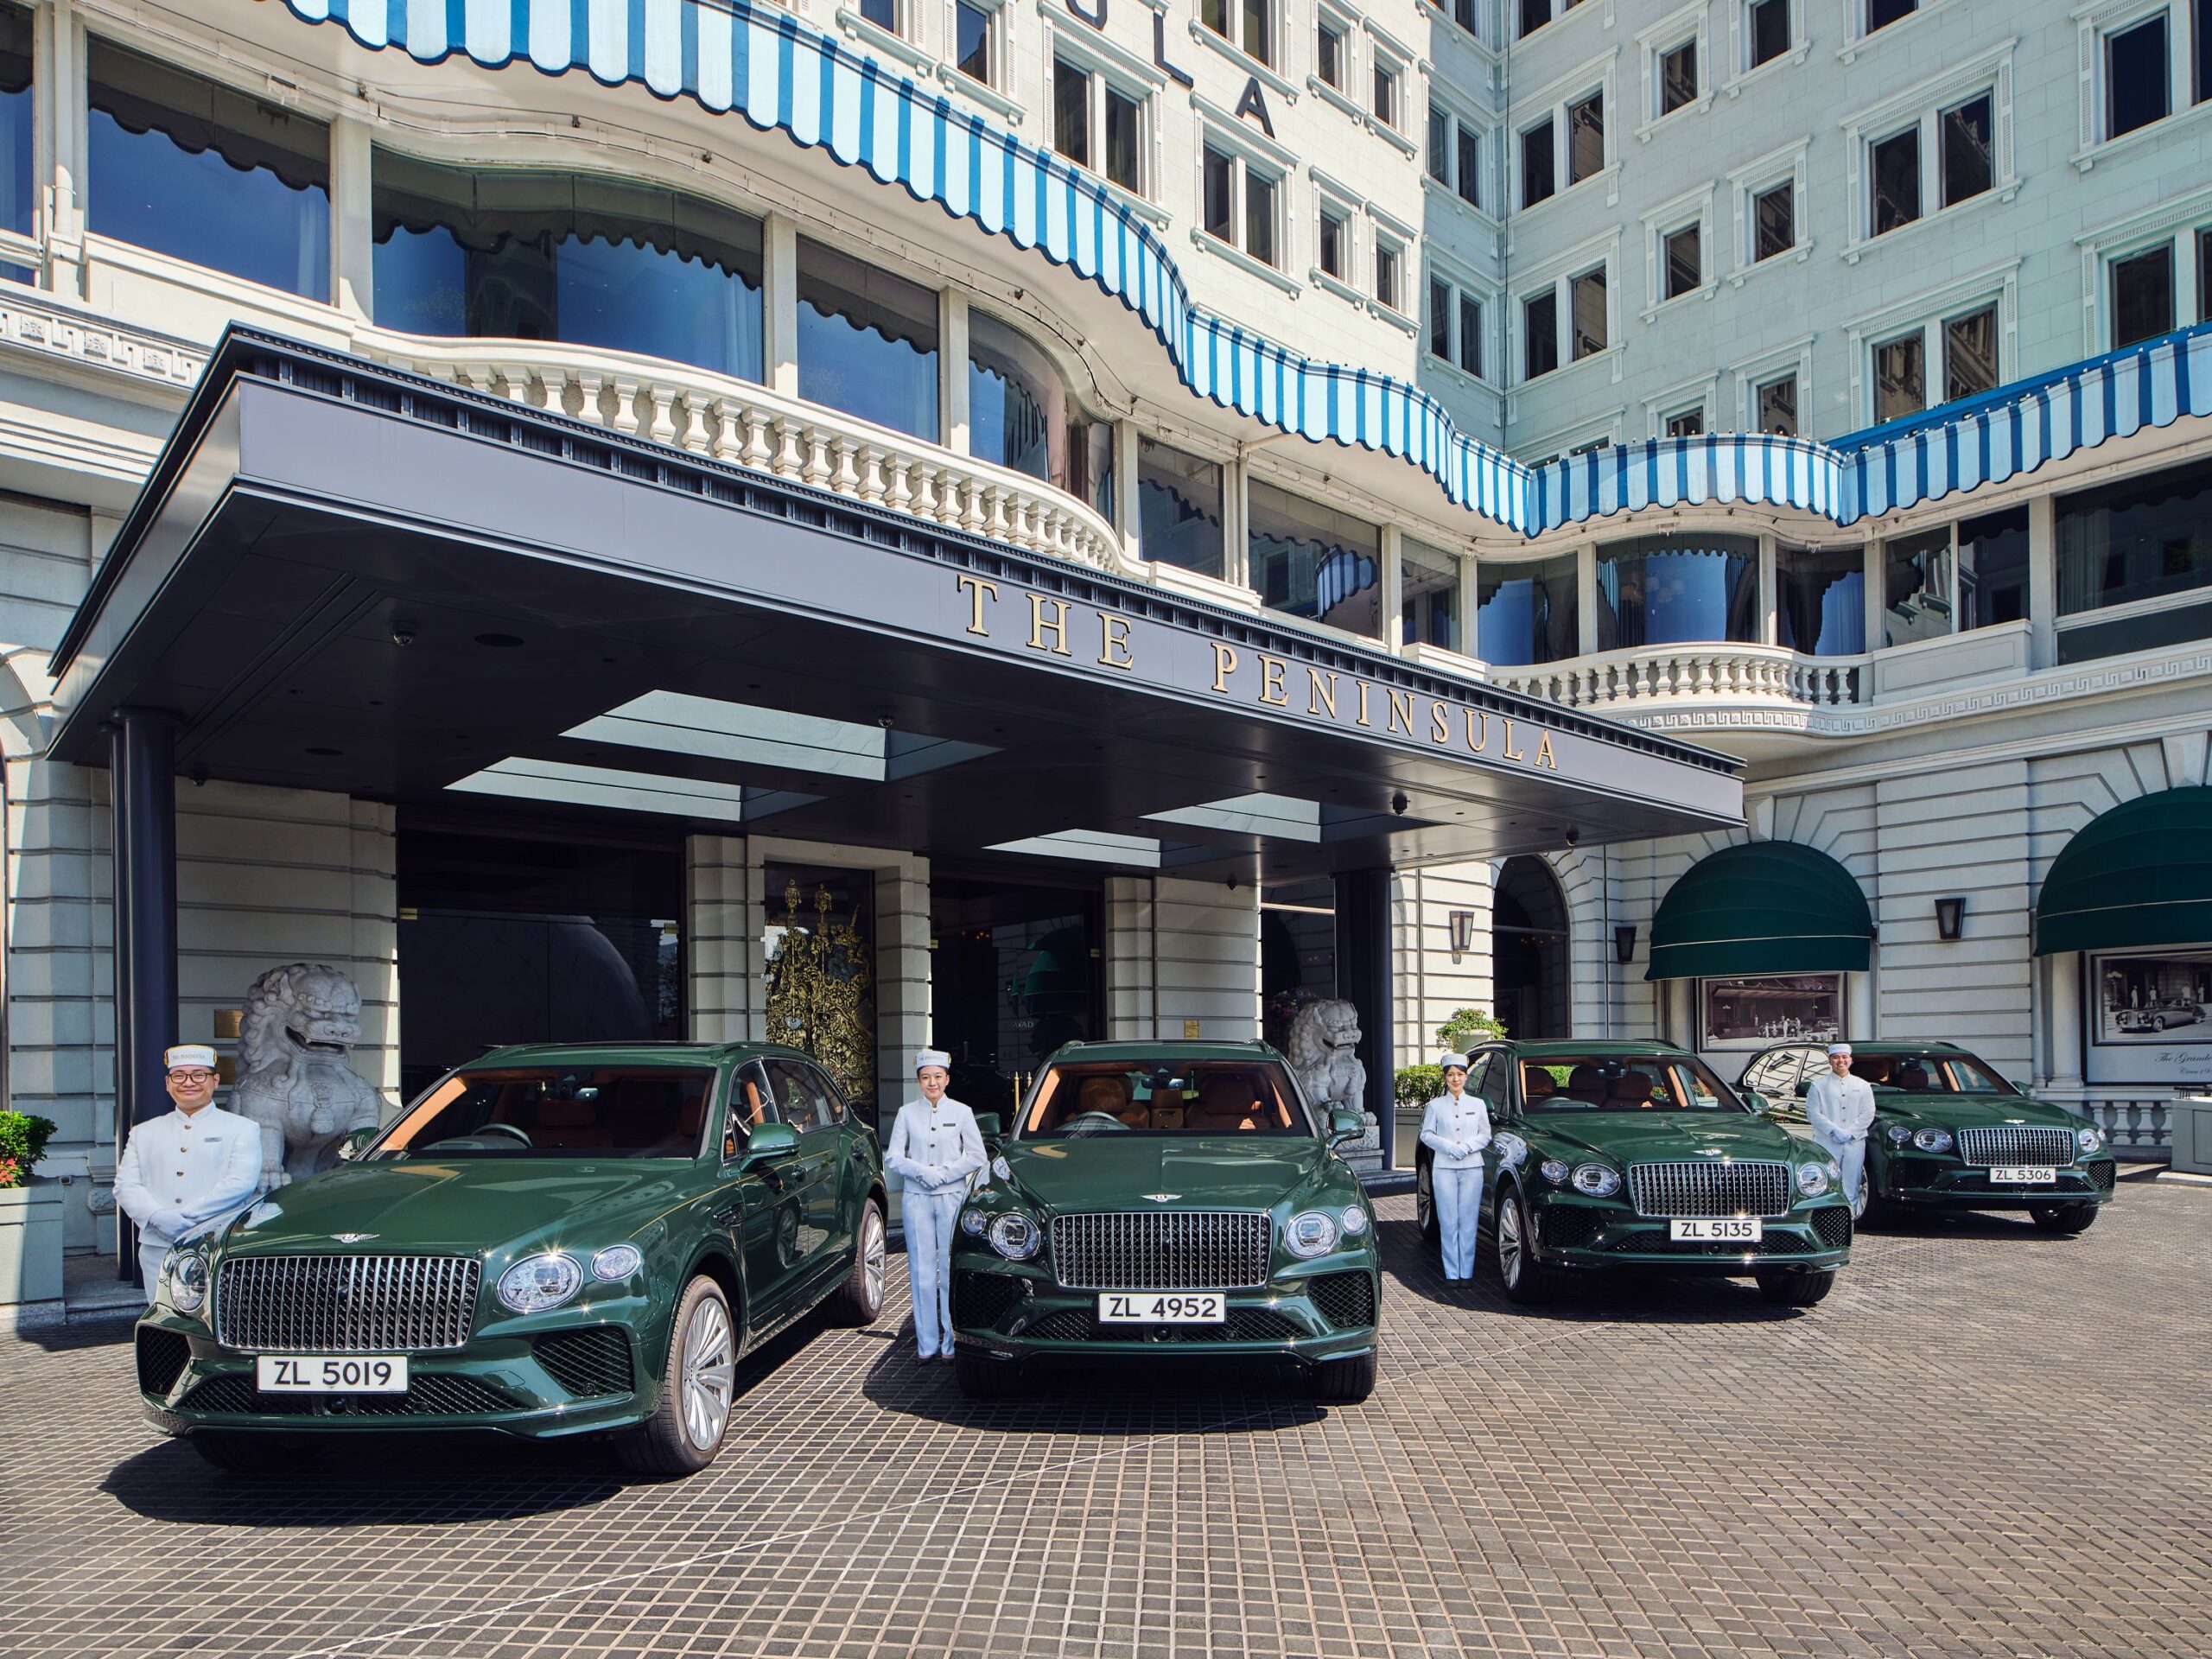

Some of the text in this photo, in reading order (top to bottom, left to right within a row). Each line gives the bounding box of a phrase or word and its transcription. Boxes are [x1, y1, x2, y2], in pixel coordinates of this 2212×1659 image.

[957, 574, 1558, 770] THE PENINSULA
[2154, 1052, 2173, 1062] The
[1995, 1170, 2051, 1180] ZL 5306
[1681, 1223, 1752, 1236] ZL 5135
[1109, 1297, 1217, 1318] ZL 4952
[274, 1361, 392, 1386] ZL 5019
